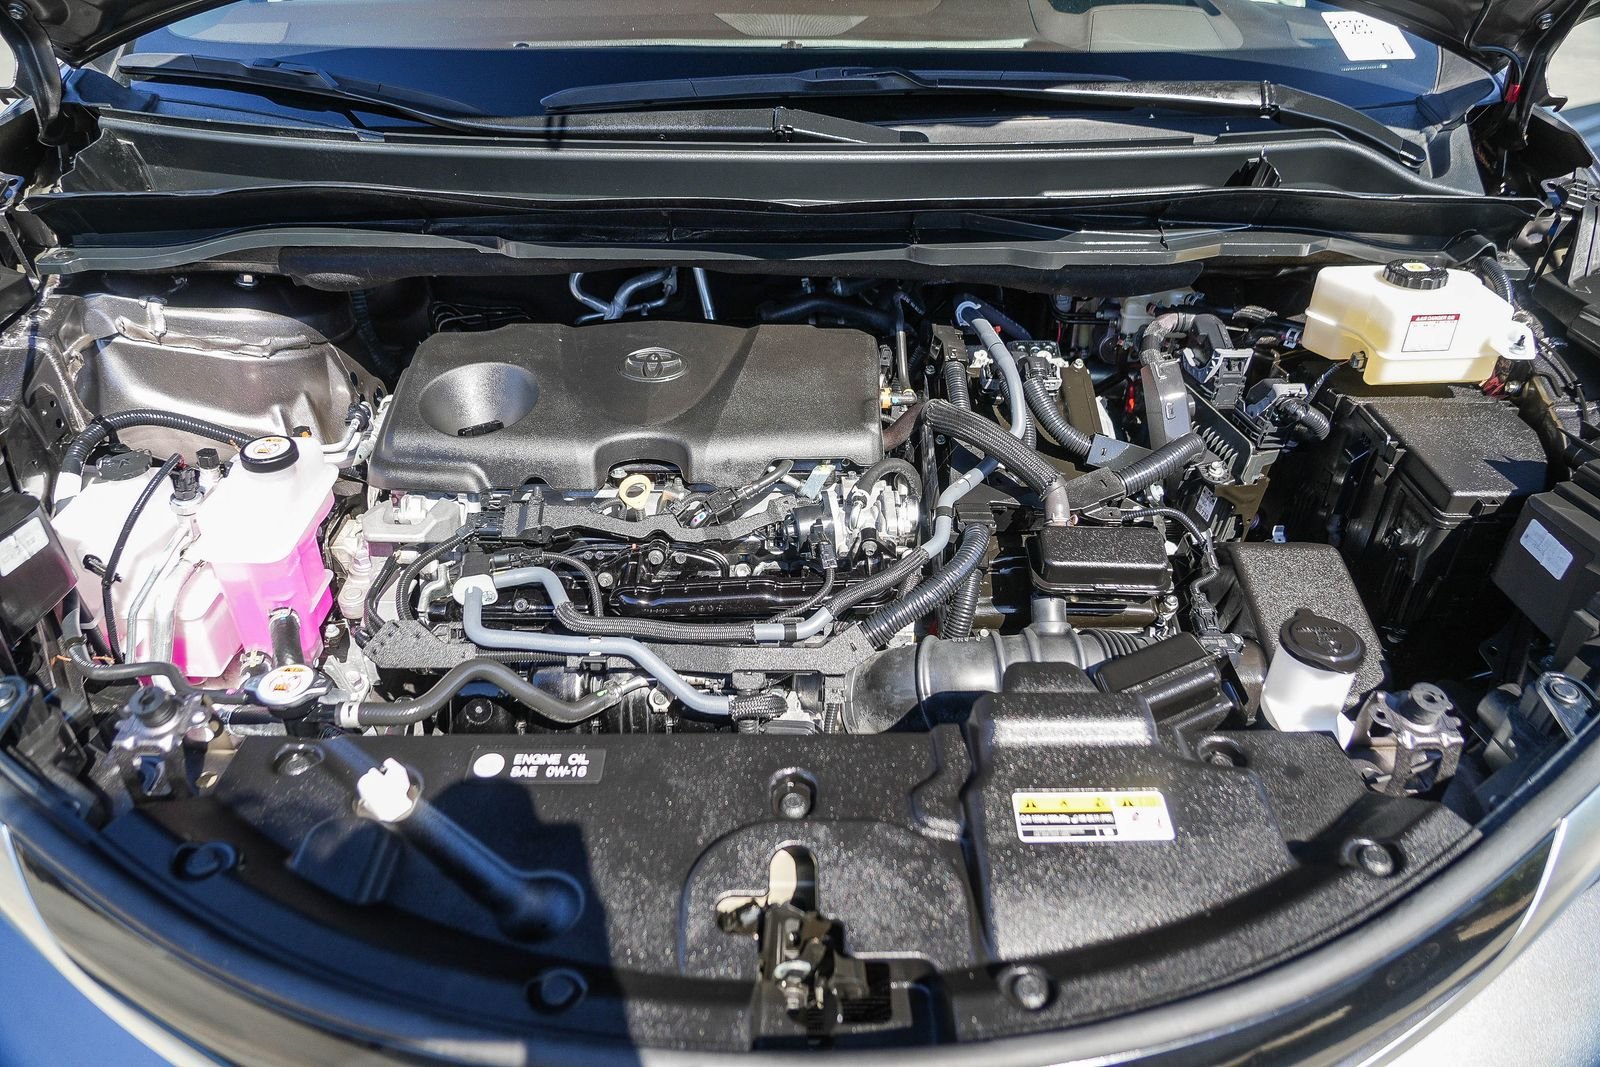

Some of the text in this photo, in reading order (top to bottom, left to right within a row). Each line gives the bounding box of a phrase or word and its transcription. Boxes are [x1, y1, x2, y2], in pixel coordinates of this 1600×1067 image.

[513, 753, 590, 765] ENGINE OIL
[510, 765, 588, 778] SAE 0W-16
